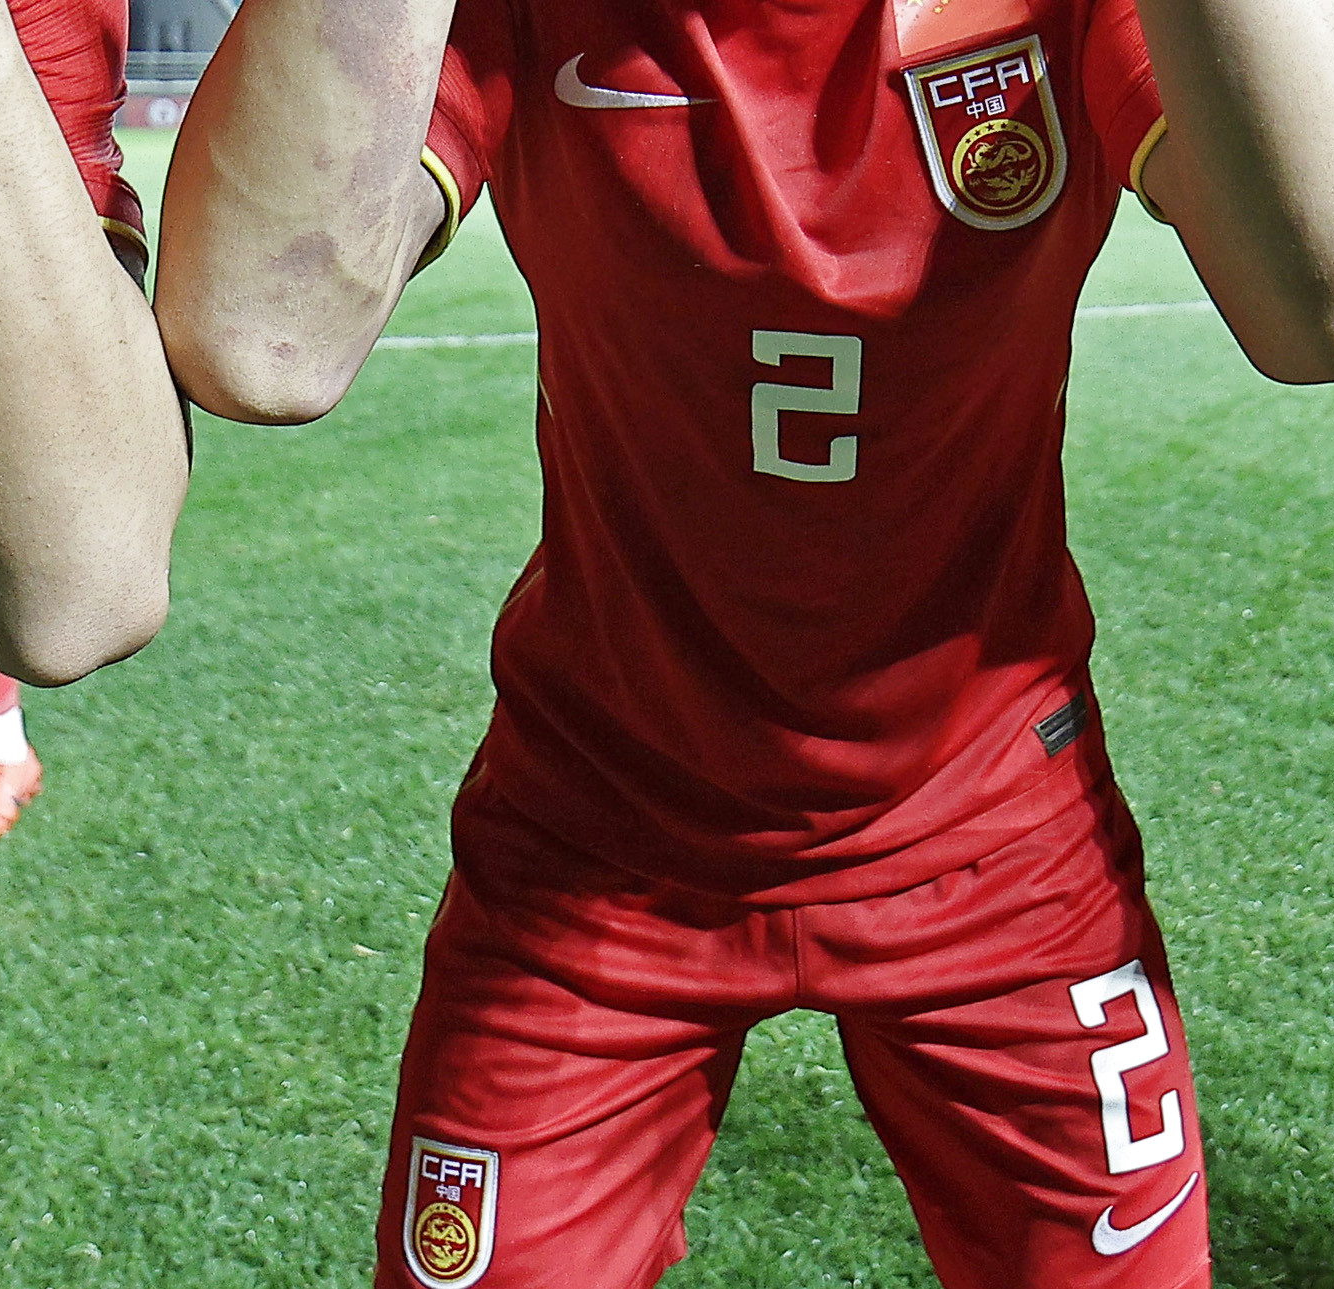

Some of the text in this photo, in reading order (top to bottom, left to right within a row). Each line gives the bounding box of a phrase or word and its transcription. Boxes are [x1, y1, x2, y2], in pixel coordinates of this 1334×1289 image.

[928, 56, 1030, 108] CFA
[966, 94, 1006, 119] 中国
[752, 330, 862, 482] 2
[1069, 959, 1185, 1174] 2
[421, 1154, 483, 1188] CFA
